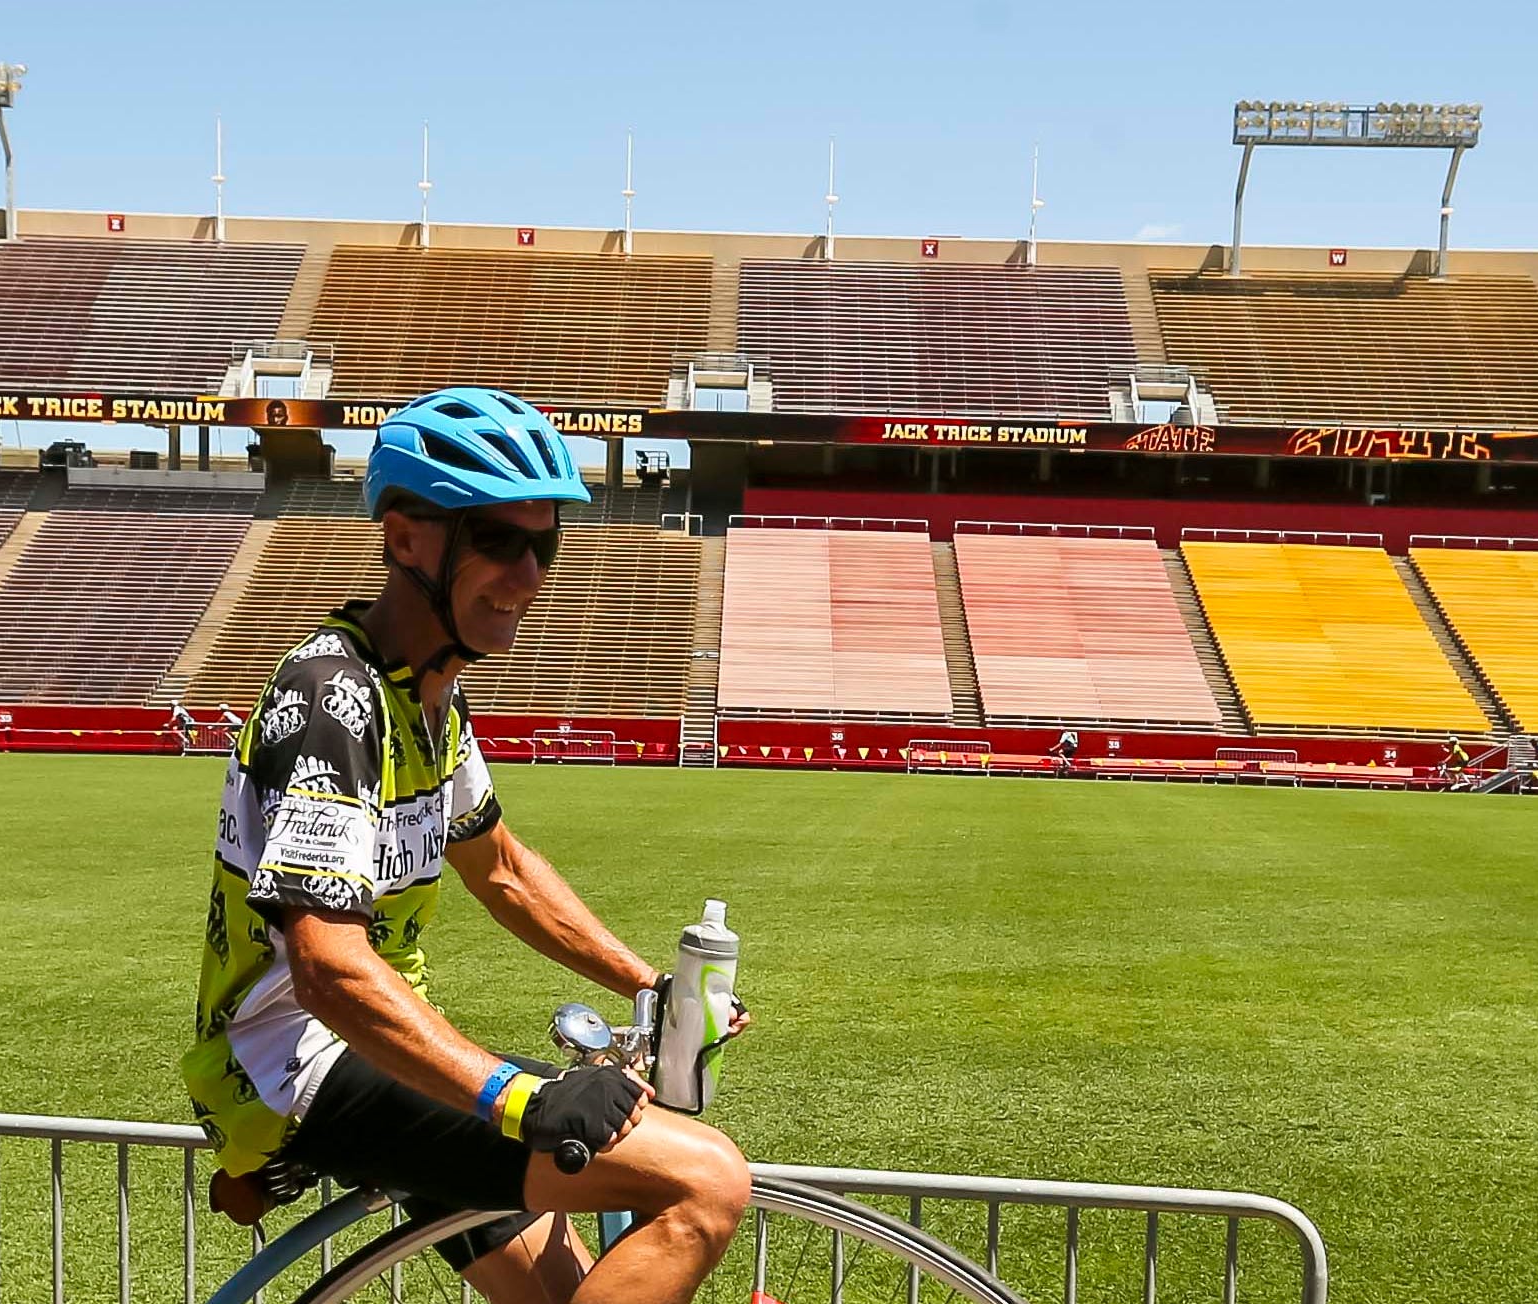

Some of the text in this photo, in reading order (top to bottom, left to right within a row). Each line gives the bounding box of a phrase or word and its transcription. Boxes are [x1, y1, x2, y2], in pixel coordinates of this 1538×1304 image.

[26, 397, 103, 418] TRICE
[112, 398, 226, 422] STADIUM
[342, 406, 643, 433] HOM CLONES
[882, 423, 1087, 444] JACK TRICE STADIUM
[267, 806, 359, 845] Frederick
